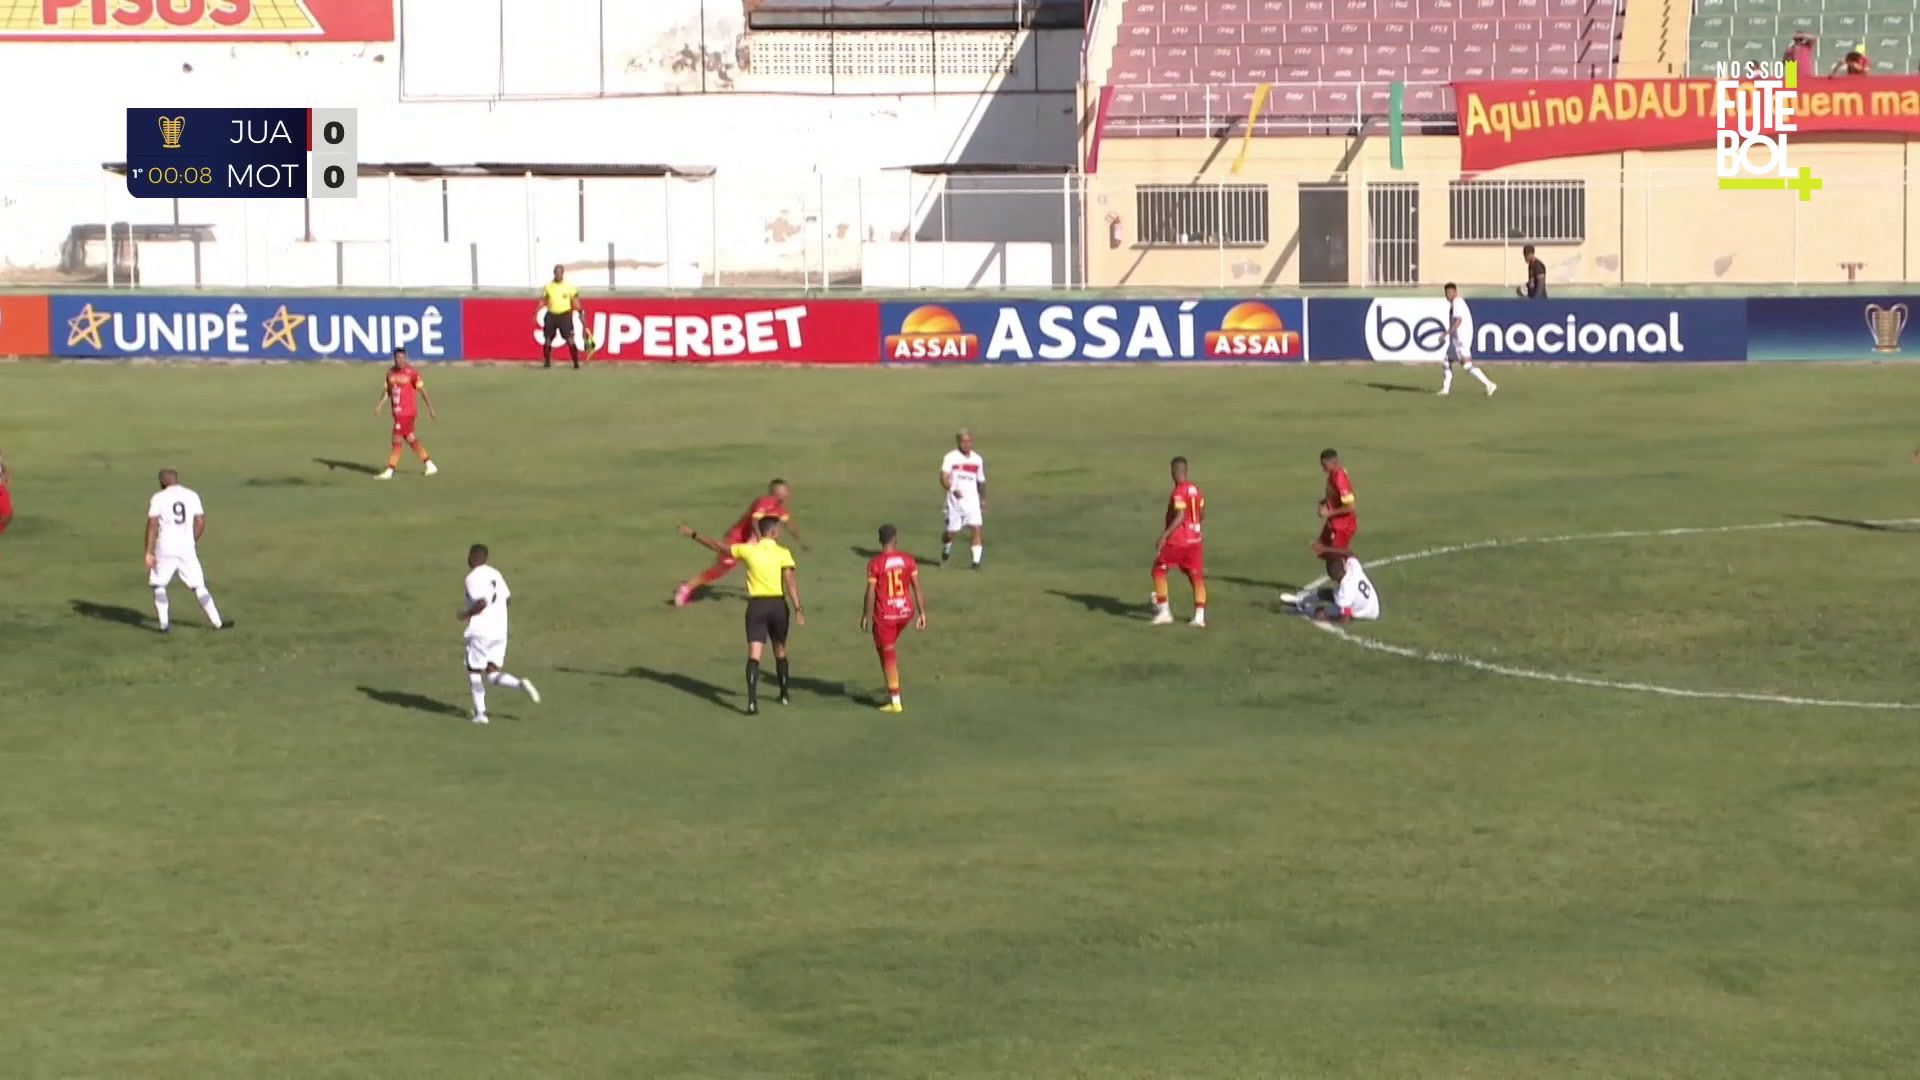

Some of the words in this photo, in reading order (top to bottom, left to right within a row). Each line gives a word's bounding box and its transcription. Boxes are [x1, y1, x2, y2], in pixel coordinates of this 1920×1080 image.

[1465, 89, 1541, 142] Aqui
[1546, 95, 1583, 127] no
[113, 303, 249, 353] UNIPÊ
[307, 305, 445, 355] UNIPÊ
[986, 301, 1199, 360] ASSAÍ
[1477, 312, 1684, 354] nacional
[172, 501, 186, 525] 9
[886, 568, 905, 597] 15
[1358, 579, 1371, 600] 8
